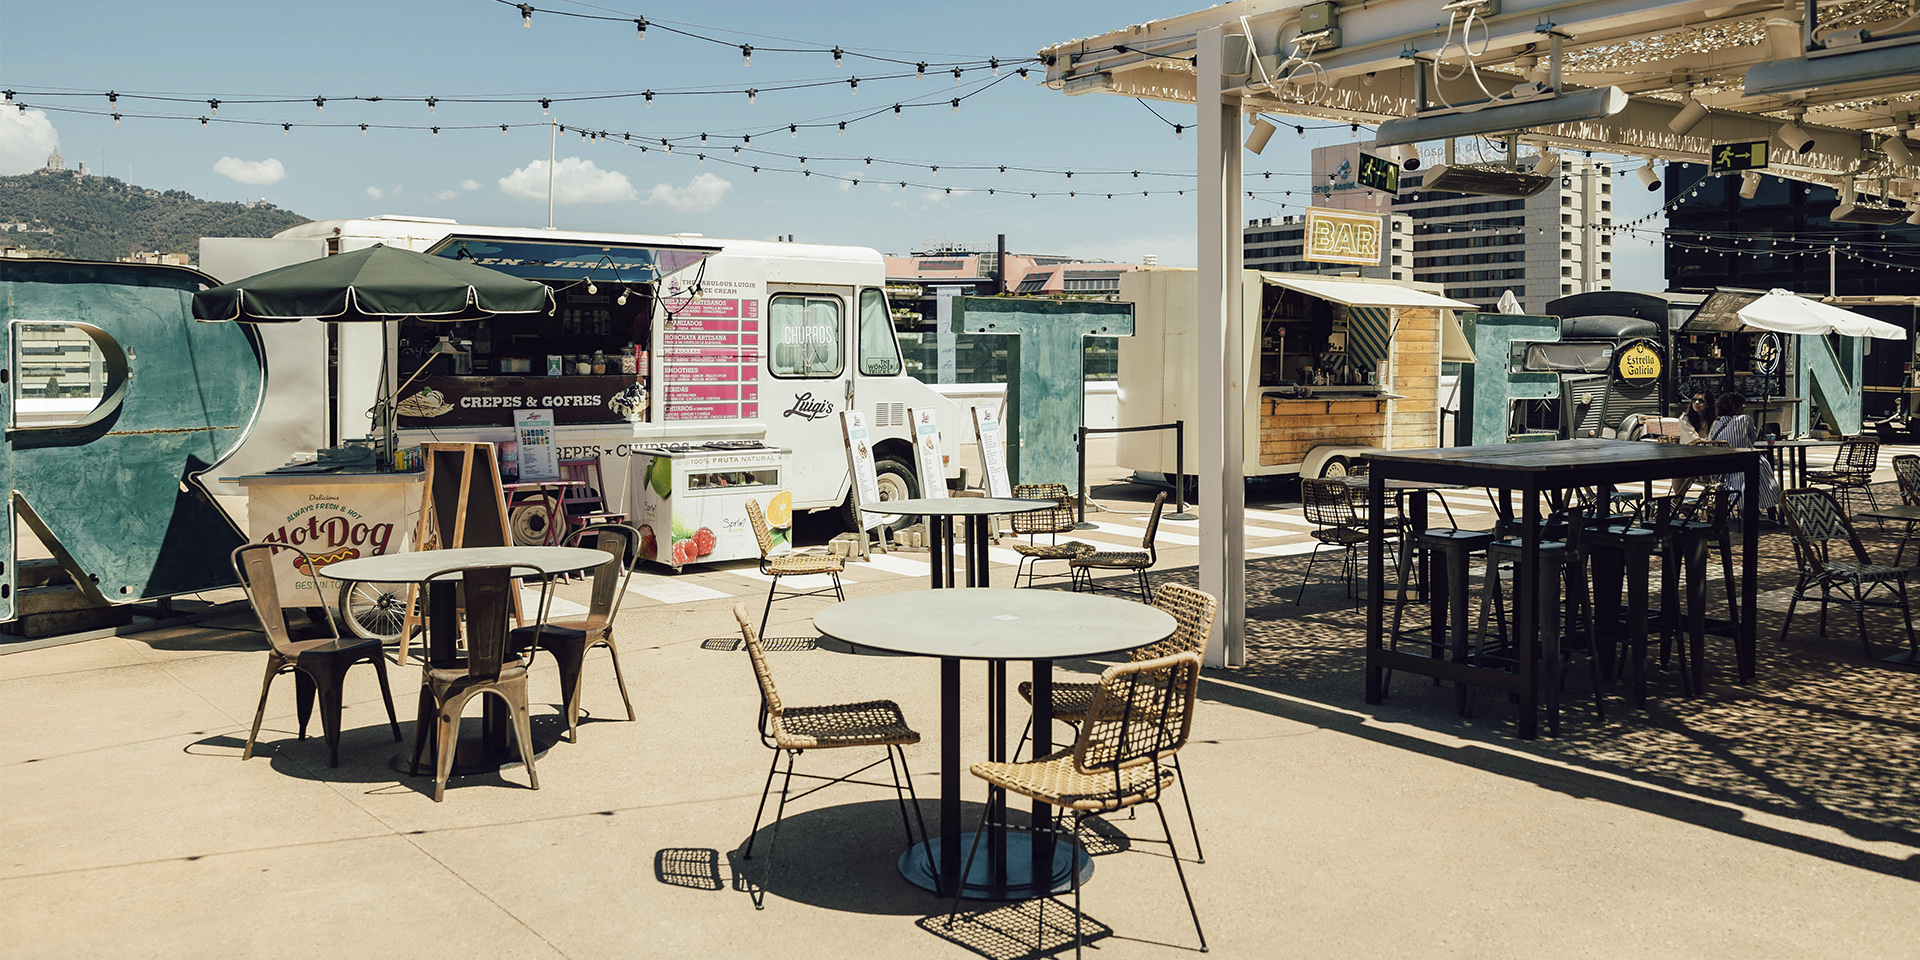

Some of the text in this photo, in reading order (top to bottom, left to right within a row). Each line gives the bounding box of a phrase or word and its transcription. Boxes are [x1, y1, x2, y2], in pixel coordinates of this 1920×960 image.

[1314, 219, 1377, 255] BAR
[784, 325, 833, 345] CHURROS
[1626, 355, 1655, 365] Estrella
[1627, 365, 1654, 375] Galicia
[1460, 311, 1563, 446] E
[1793, 333, 1864, 438] N
[460, 394, 602, 408] CREPES & GOFRES
[783, 391, 834, 422] Luigi's
[951, 296, 1135, 496] T
[556, 444, 601, 460] REPES
[286, 502, 363, 523] ALWAYS FRESH & HOT
